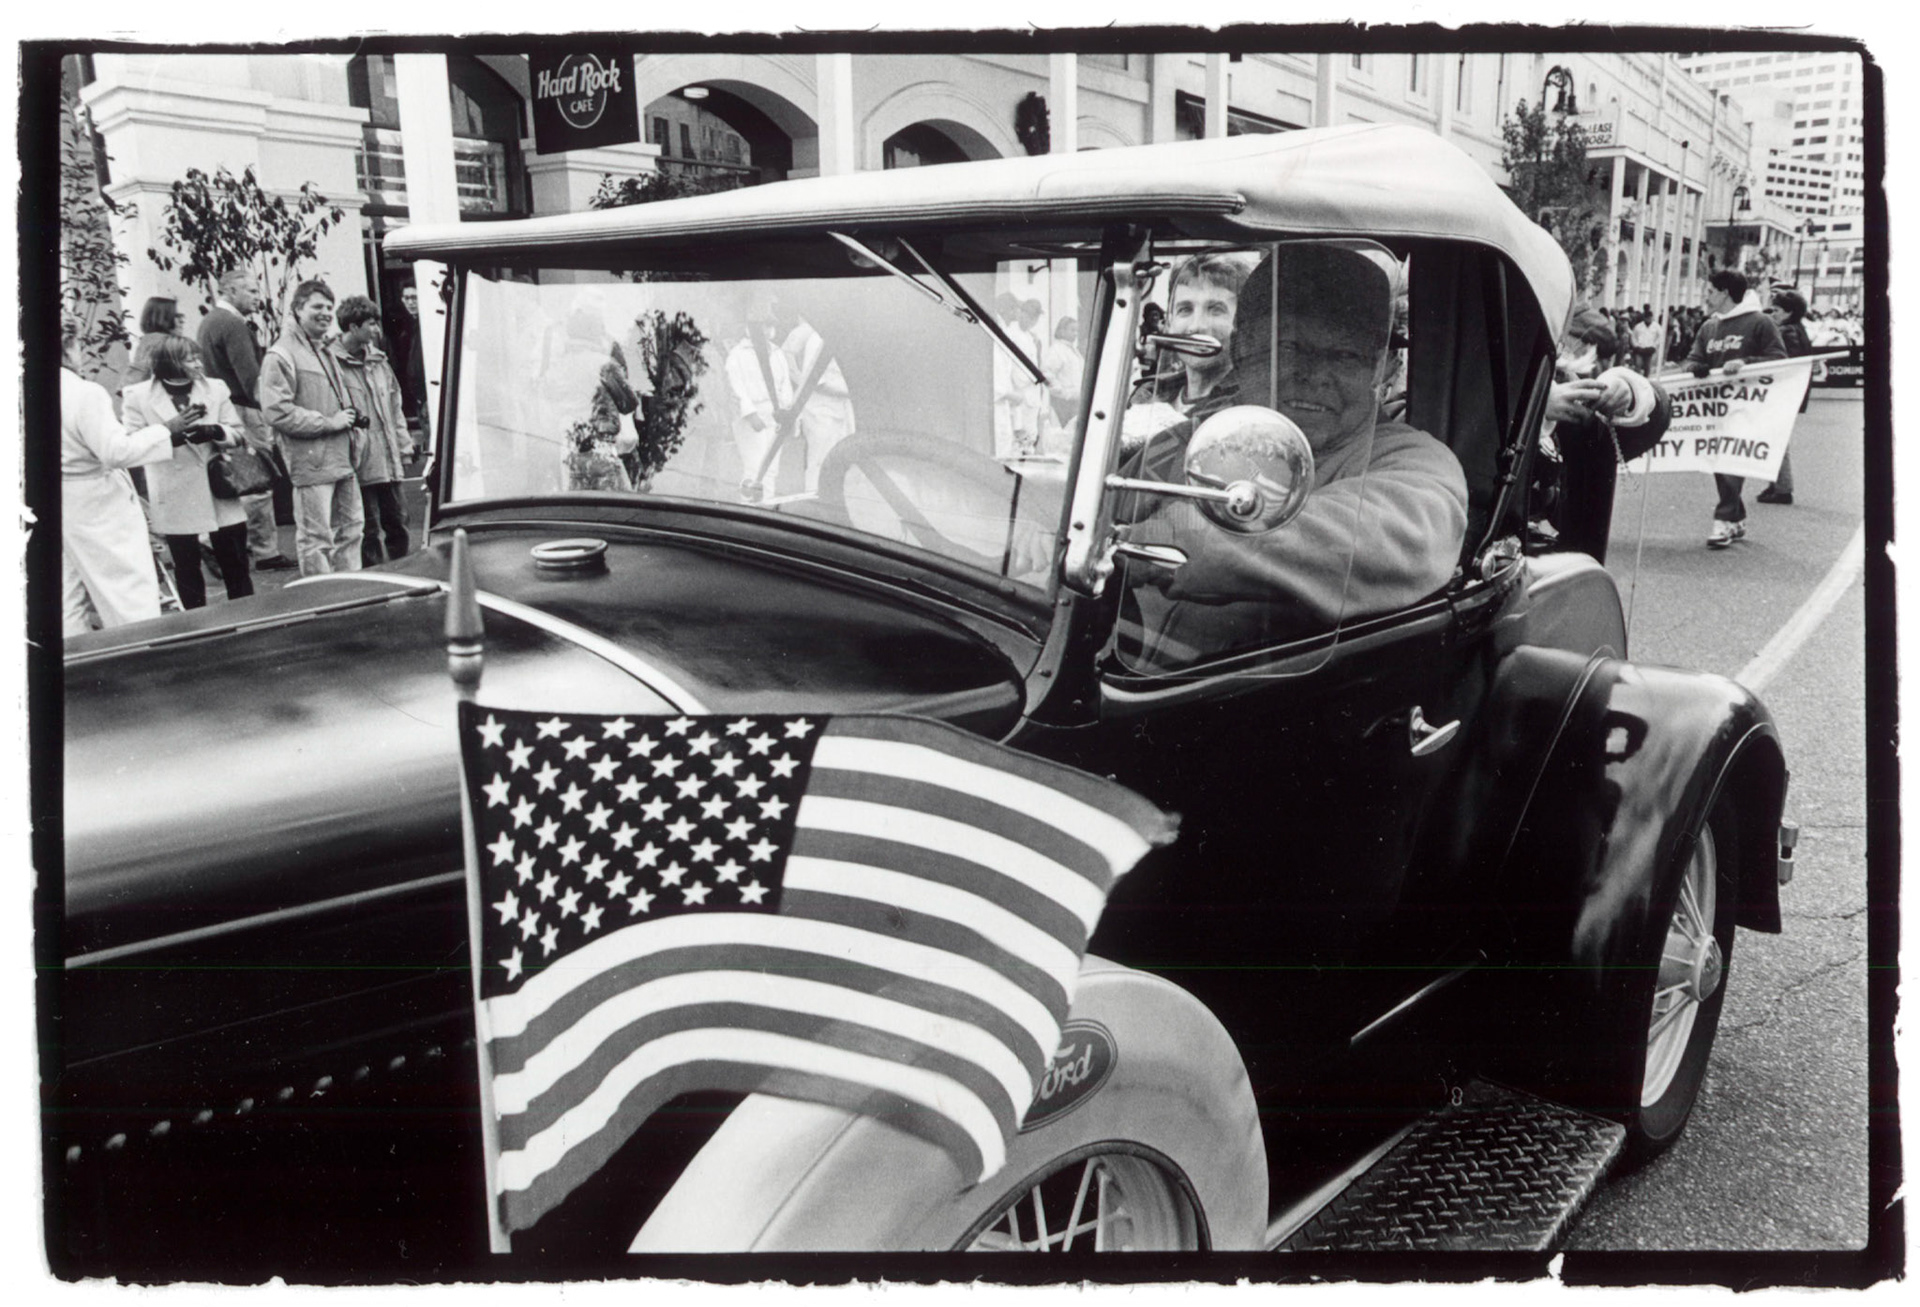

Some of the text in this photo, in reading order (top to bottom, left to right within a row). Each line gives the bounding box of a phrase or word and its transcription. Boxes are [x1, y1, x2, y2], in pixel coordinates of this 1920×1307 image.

[538, 58, 622, 99] Hard Rock
[570, 99, 594, 114] CAFE
[1670, 402, 1729, 418] BAND
